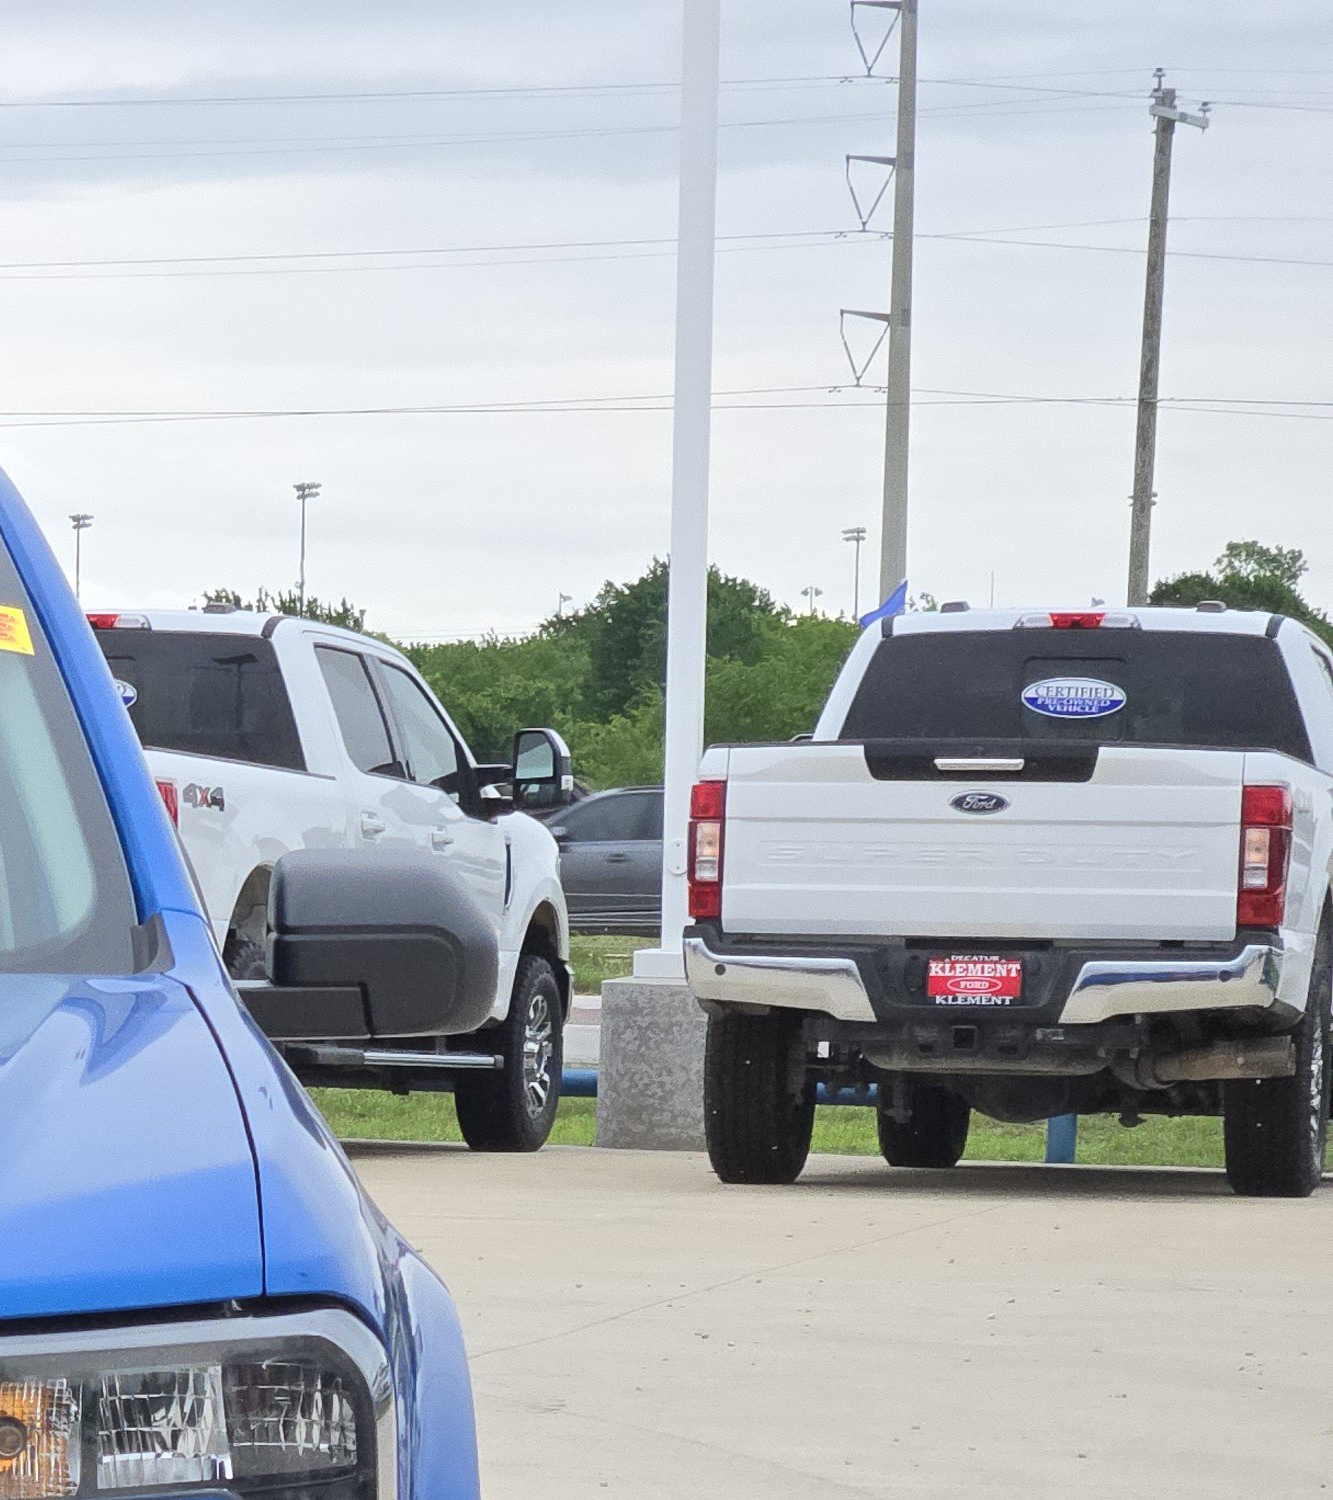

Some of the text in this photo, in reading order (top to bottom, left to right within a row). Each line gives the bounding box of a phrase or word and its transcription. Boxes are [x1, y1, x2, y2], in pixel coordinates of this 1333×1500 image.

[1035, 685, 1115, 699] CERTIFIED
[929, 963, 1021, 977] KLEMENT
[960, 981, 989, 989] FORD
[935, 996, 1013, 1005] KLEMENT
